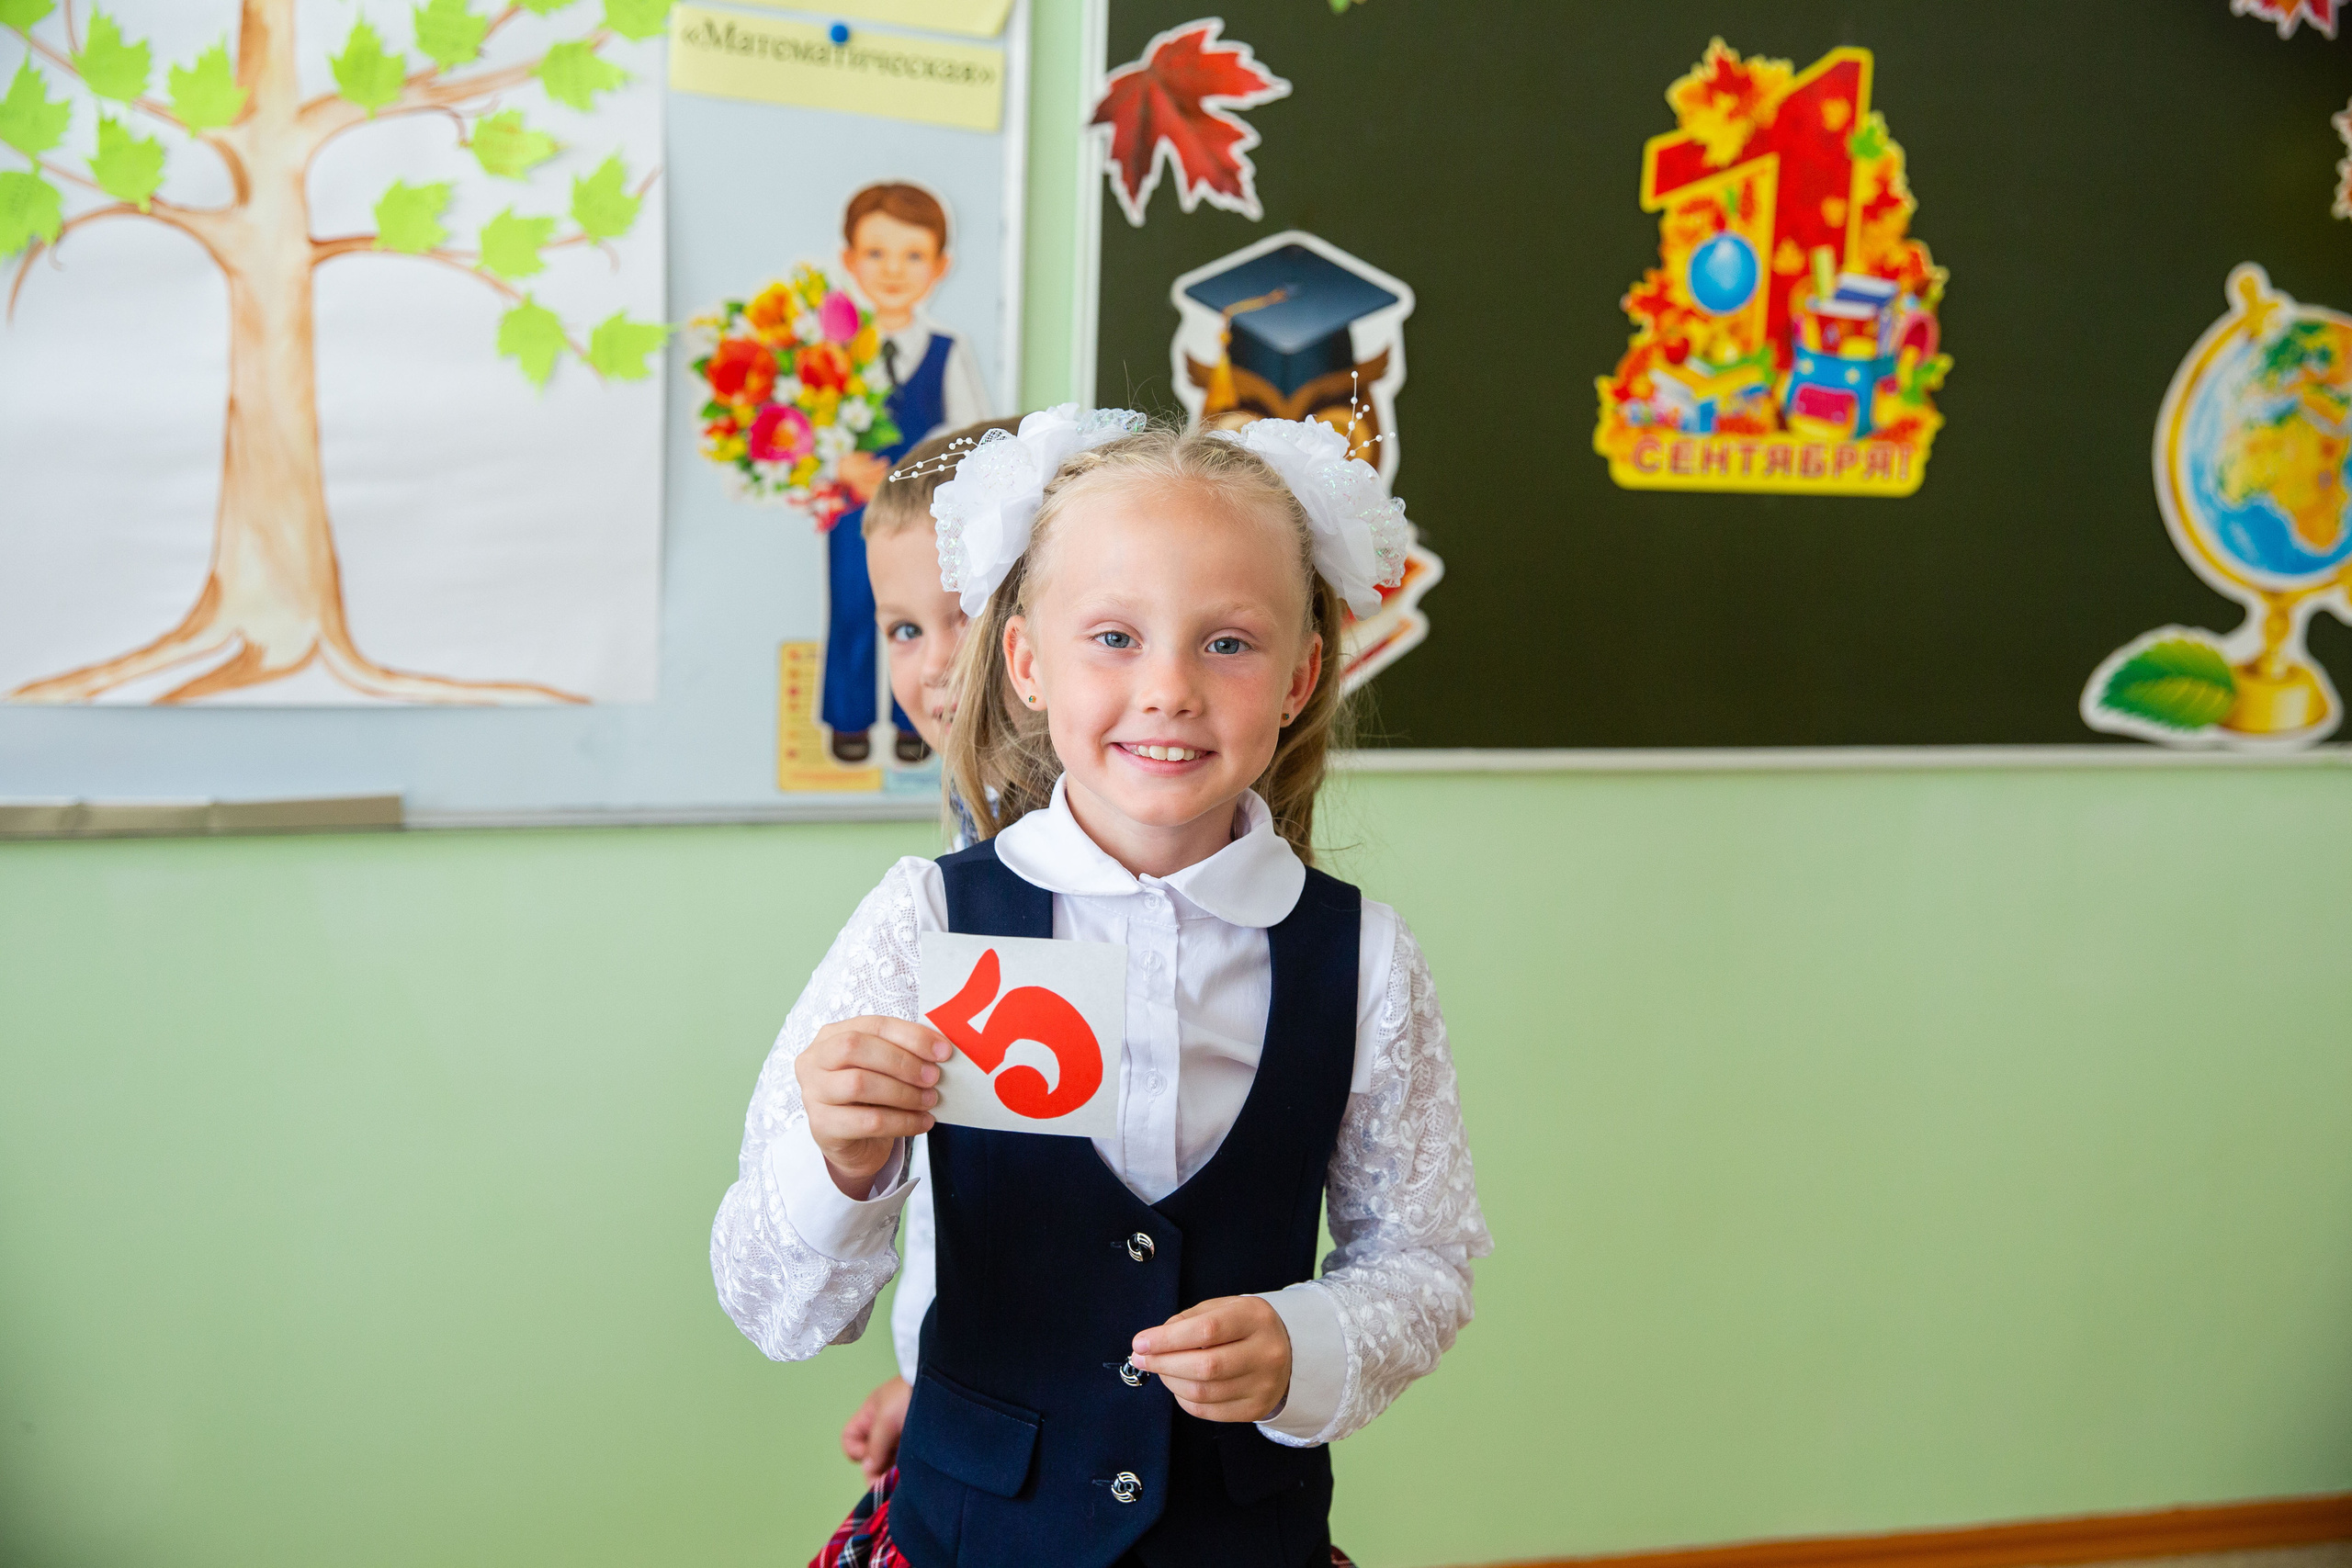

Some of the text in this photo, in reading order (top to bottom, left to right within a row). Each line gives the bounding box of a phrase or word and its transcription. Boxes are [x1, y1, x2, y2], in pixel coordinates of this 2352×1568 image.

[681, 17, 998, 86] «Математическая»
[1643, 47, 1873, 378] 1
[1633, 434, 1916, 481] СЕНТЯБРЯ!
[924, 948, 1103, 1120] 5
